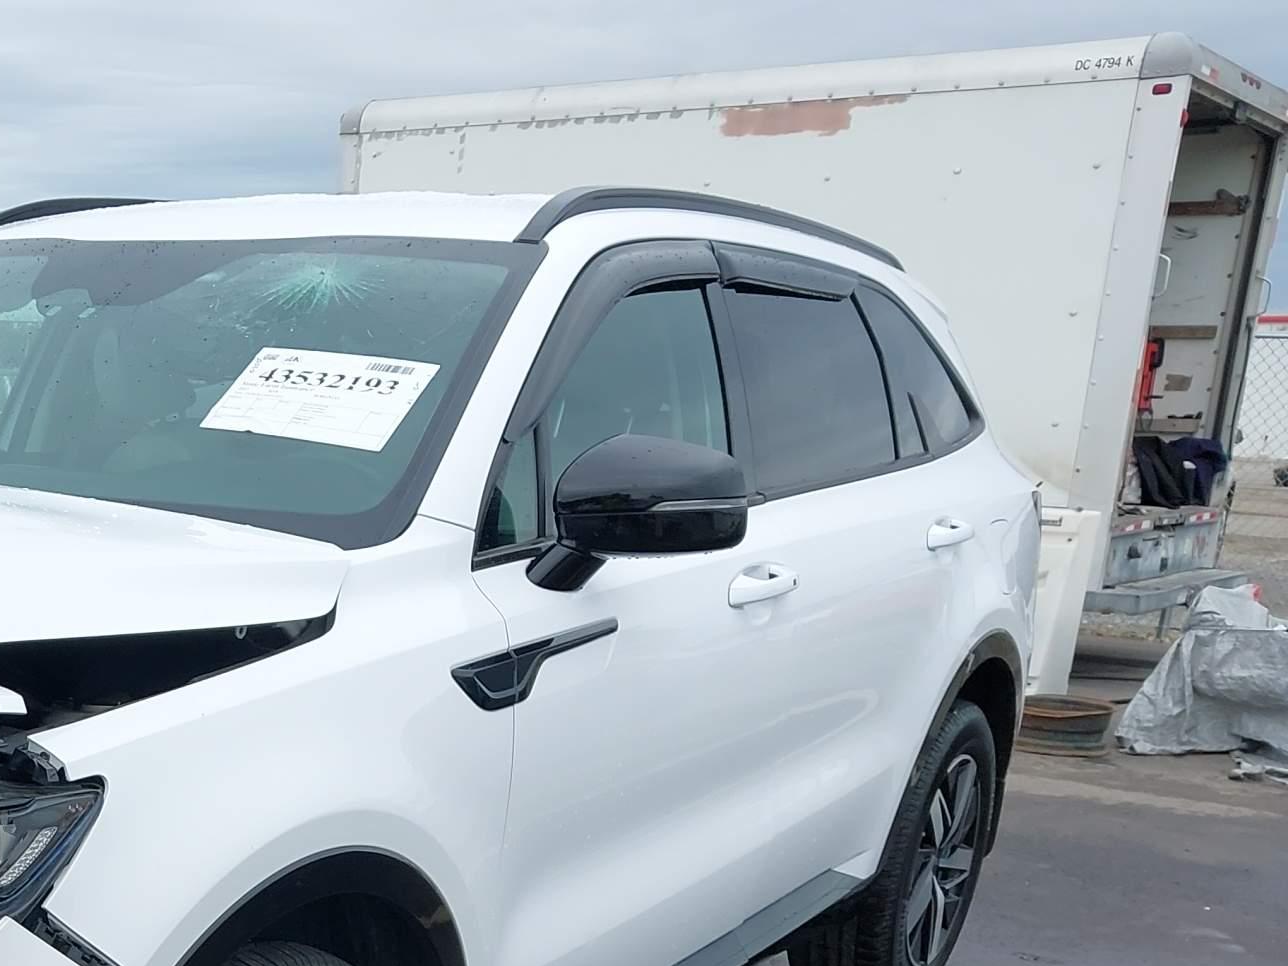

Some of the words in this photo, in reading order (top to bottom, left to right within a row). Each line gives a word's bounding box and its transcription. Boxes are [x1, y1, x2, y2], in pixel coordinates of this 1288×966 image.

[1075, 59, 1091, 71] DC
[1095, 56, 1122, 69] 4794
[1126, 55, 1135, 67] K
[259, 367, 400, 395] 43532193
